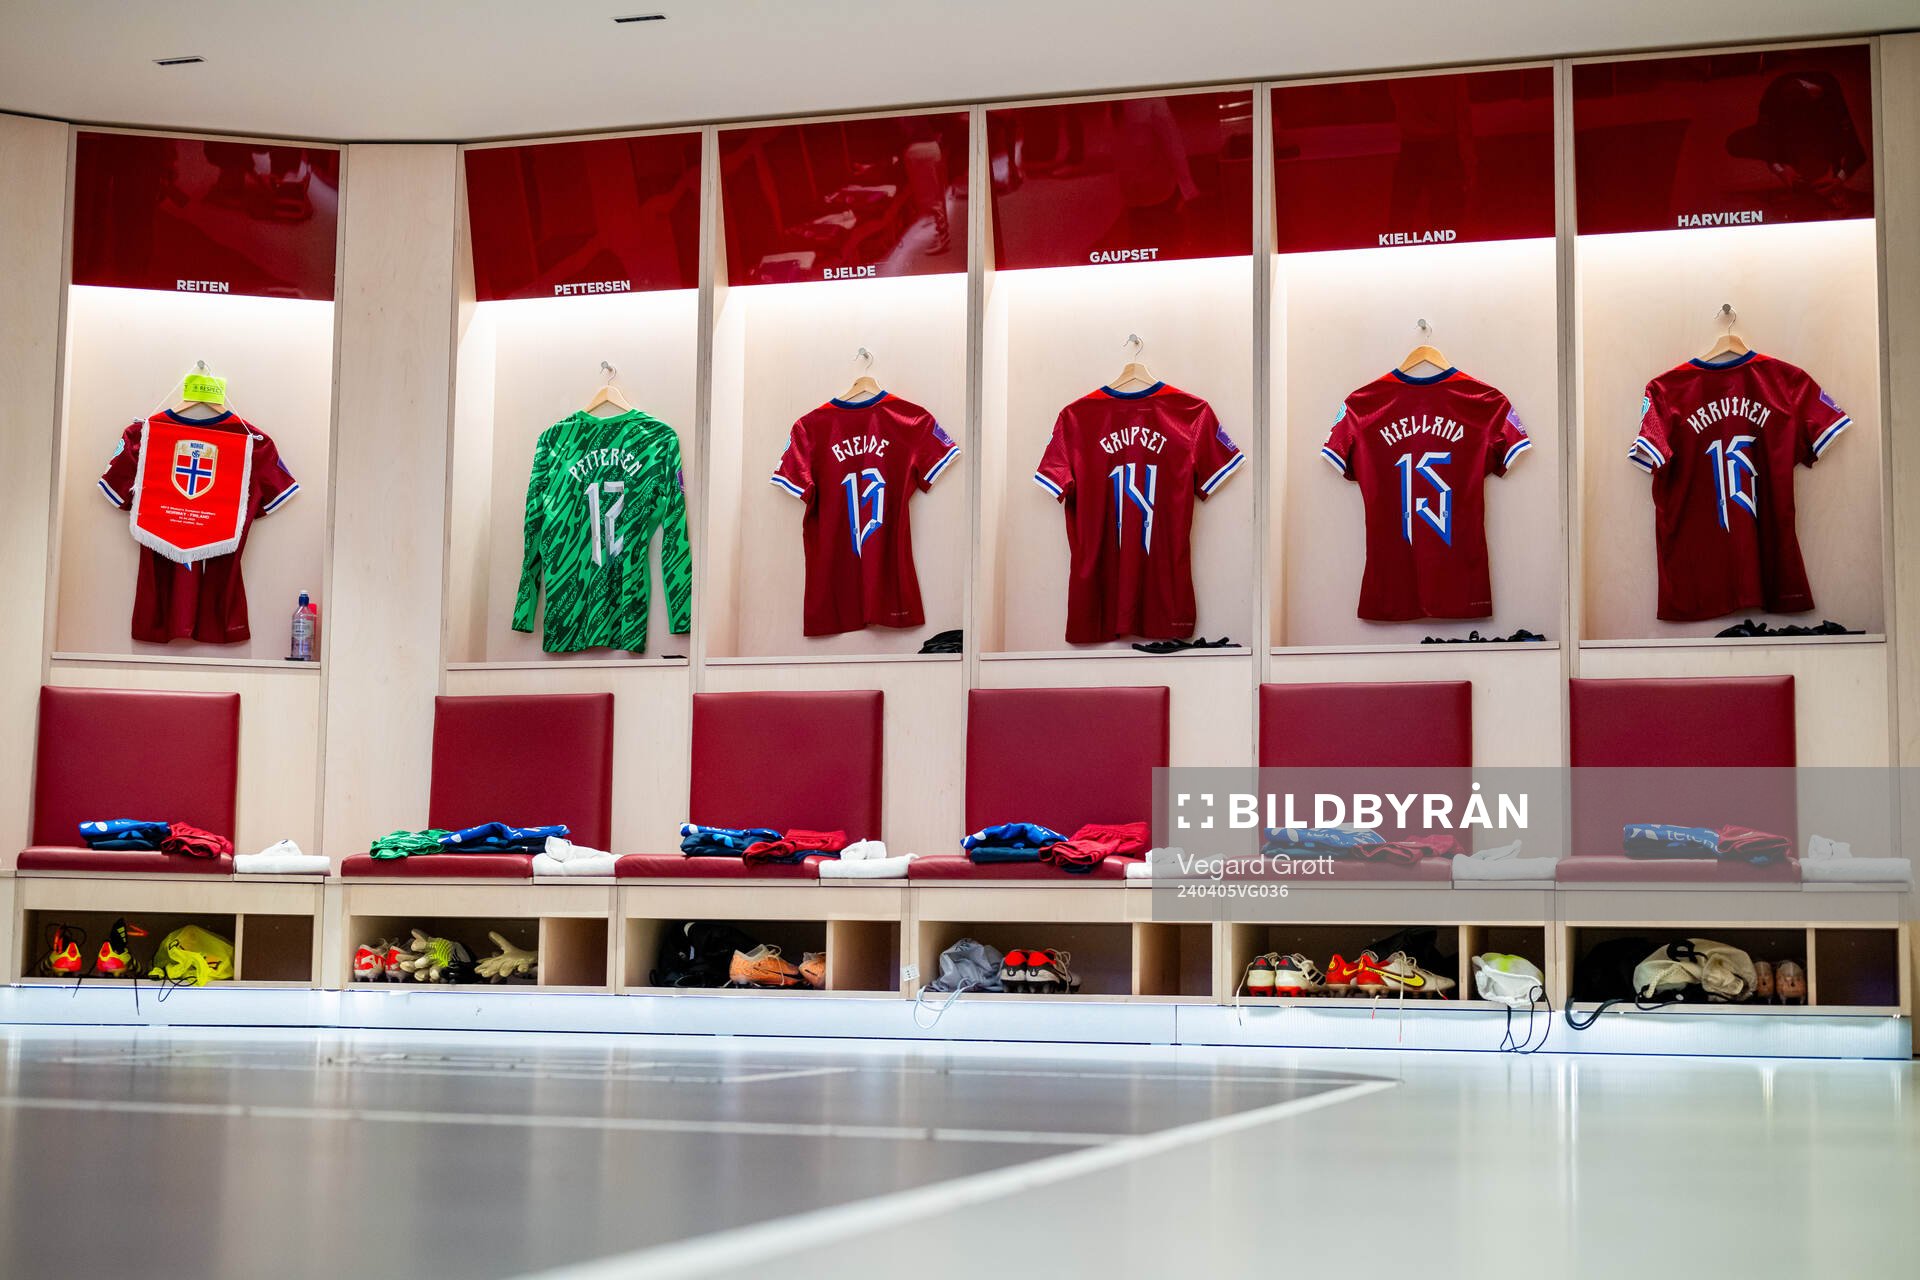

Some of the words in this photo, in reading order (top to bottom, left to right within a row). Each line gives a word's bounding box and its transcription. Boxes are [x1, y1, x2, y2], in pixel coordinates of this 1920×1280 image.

[1677, 210, 1764, 229] HARVIKEN
[1378, 229, 1457, 246] KIELLAND
[1089, 247, 1159, 263] GAUPSET
[176, 279, 230, 293] REITEN
[823, 265, 876, 280] BJELDE
[554, 279, 632, 296] PETTERSEN
[1687, 396, 1772, 434] HARVIKEN
[1099, 426, 1168, 454] GAUPSET
[1379, 414, 1465, 447] KIELLAND
[832, 435, 890, 463] BJELDE
[1704, 435, 1759, 533] 16
[840, 467, 887, 560] 13
[1108, 462, 1158, 556] 14
[1394, 451, 1453, 549] 15
[584, 481, 625, 567] 12
